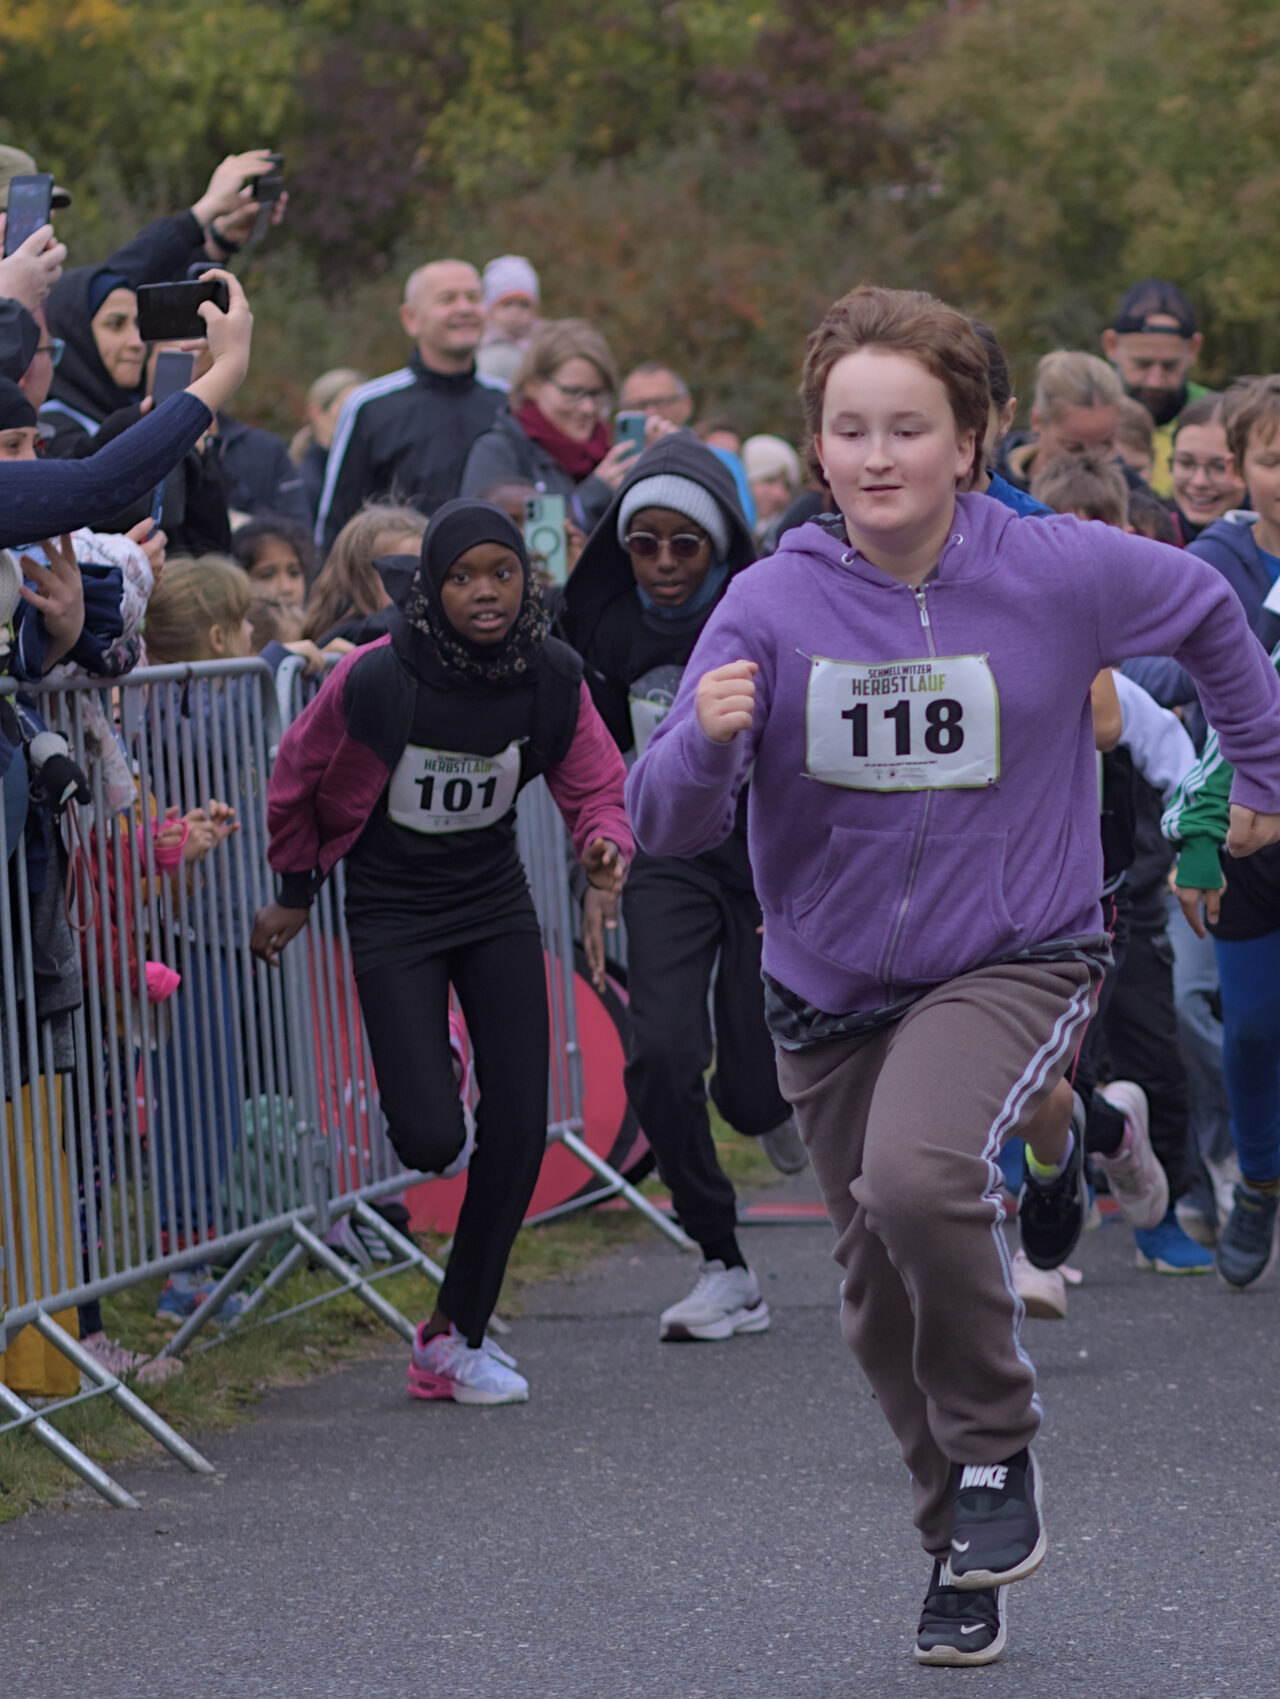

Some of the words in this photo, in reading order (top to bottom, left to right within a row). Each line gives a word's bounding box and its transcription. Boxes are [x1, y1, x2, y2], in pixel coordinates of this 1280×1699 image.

[868, 664, 932, 678] SCHMELLWITZER
[852, 674, 946, 696] HERBSTLAUF
[841, 698, 965, 758] 118
[414, 774, 498, 812] 101
[960, 1464, 1009, 1490] NIKE
